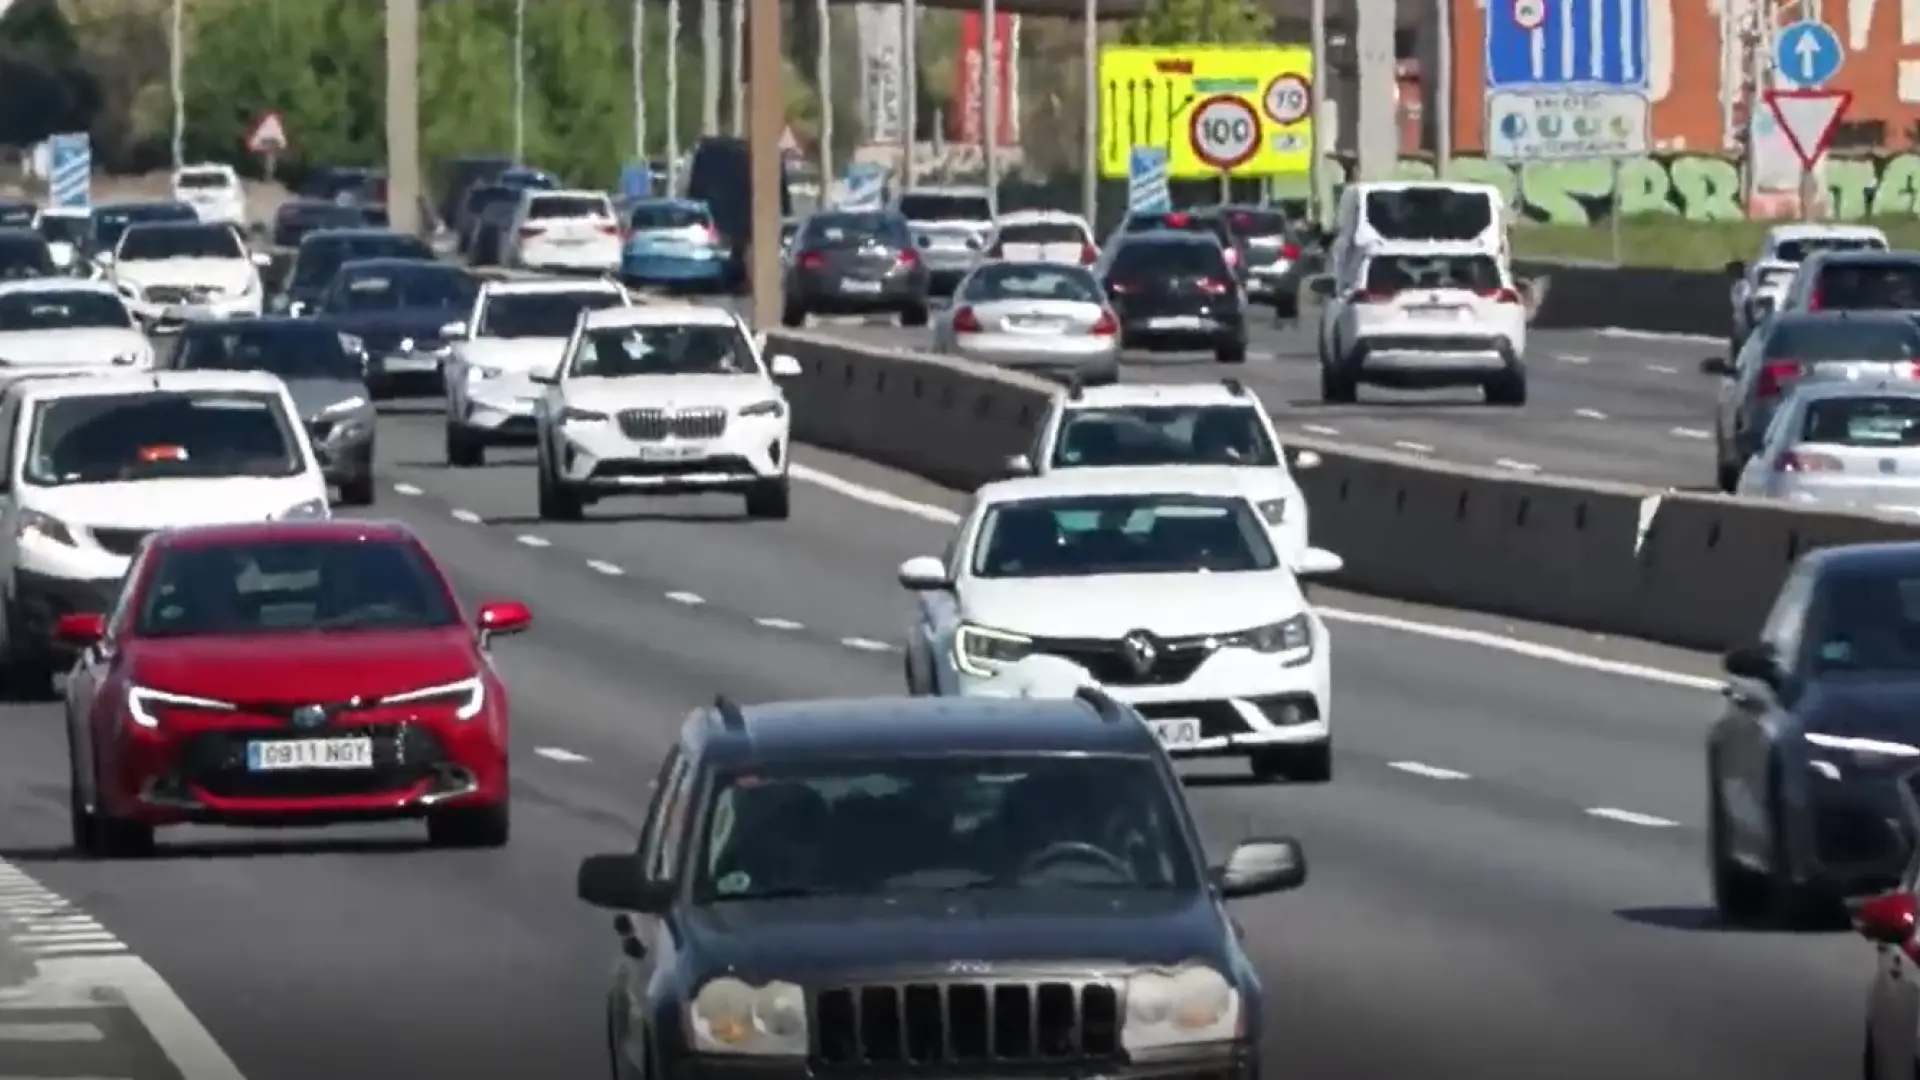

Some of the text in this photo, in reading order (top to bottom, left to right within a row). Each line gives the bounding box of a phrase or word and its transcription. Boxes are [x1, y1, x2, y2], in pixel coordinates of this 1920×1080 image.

[1275, 90, 1301, 110] 70
[1204, 117, 1250, 145] 100
[264, 743, 315, 764] 0911
